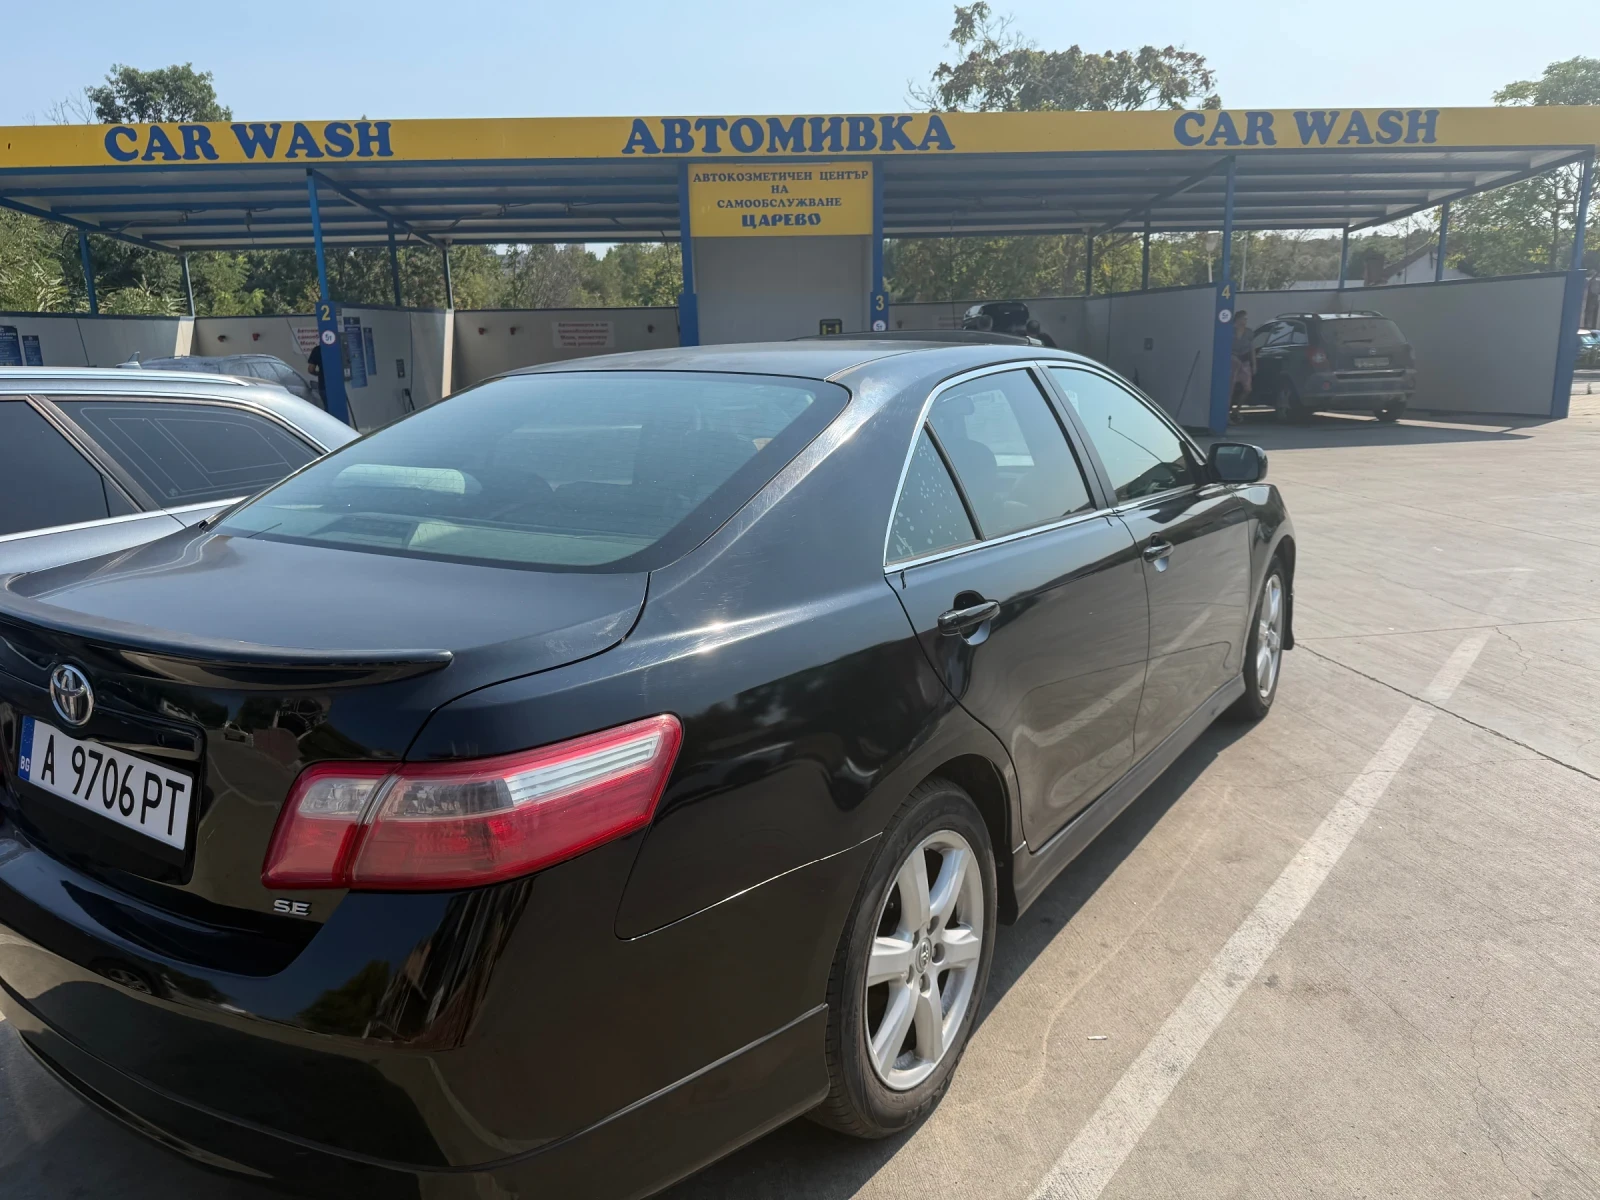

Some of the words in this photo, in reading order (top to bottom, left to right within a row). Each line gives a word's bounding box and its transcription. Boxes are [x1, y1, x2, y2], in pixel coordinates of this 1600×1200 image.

[621, 114, 956, 155] АВТОМИВКА
[1173, 109, 1277, 147] CAR
[1293, 108, 1440, 146] WASH
[104, 124, 219, 162] CAR
[230, 121, 394, 159] WASH
[693, 171, 813, 183] АВТОКОЗМЕТИЧЕН
[819, 170, 869, 182] ЦЕНТЪР
[771, 185, 789, 194] НА
[717, 197, 842, 209] САМООБСЛУЖВАНЕ
[741, 212, 822, 230] ЦАРЕВО
[1221, 284, 1231, 300] 4
[875, 294, 885, 311] 3
[321, 305, 331, 321] 2
[20, 755, 31, 772] BG
[41, 734, 55, 786] A
[273, 899, 310, 916] SE
